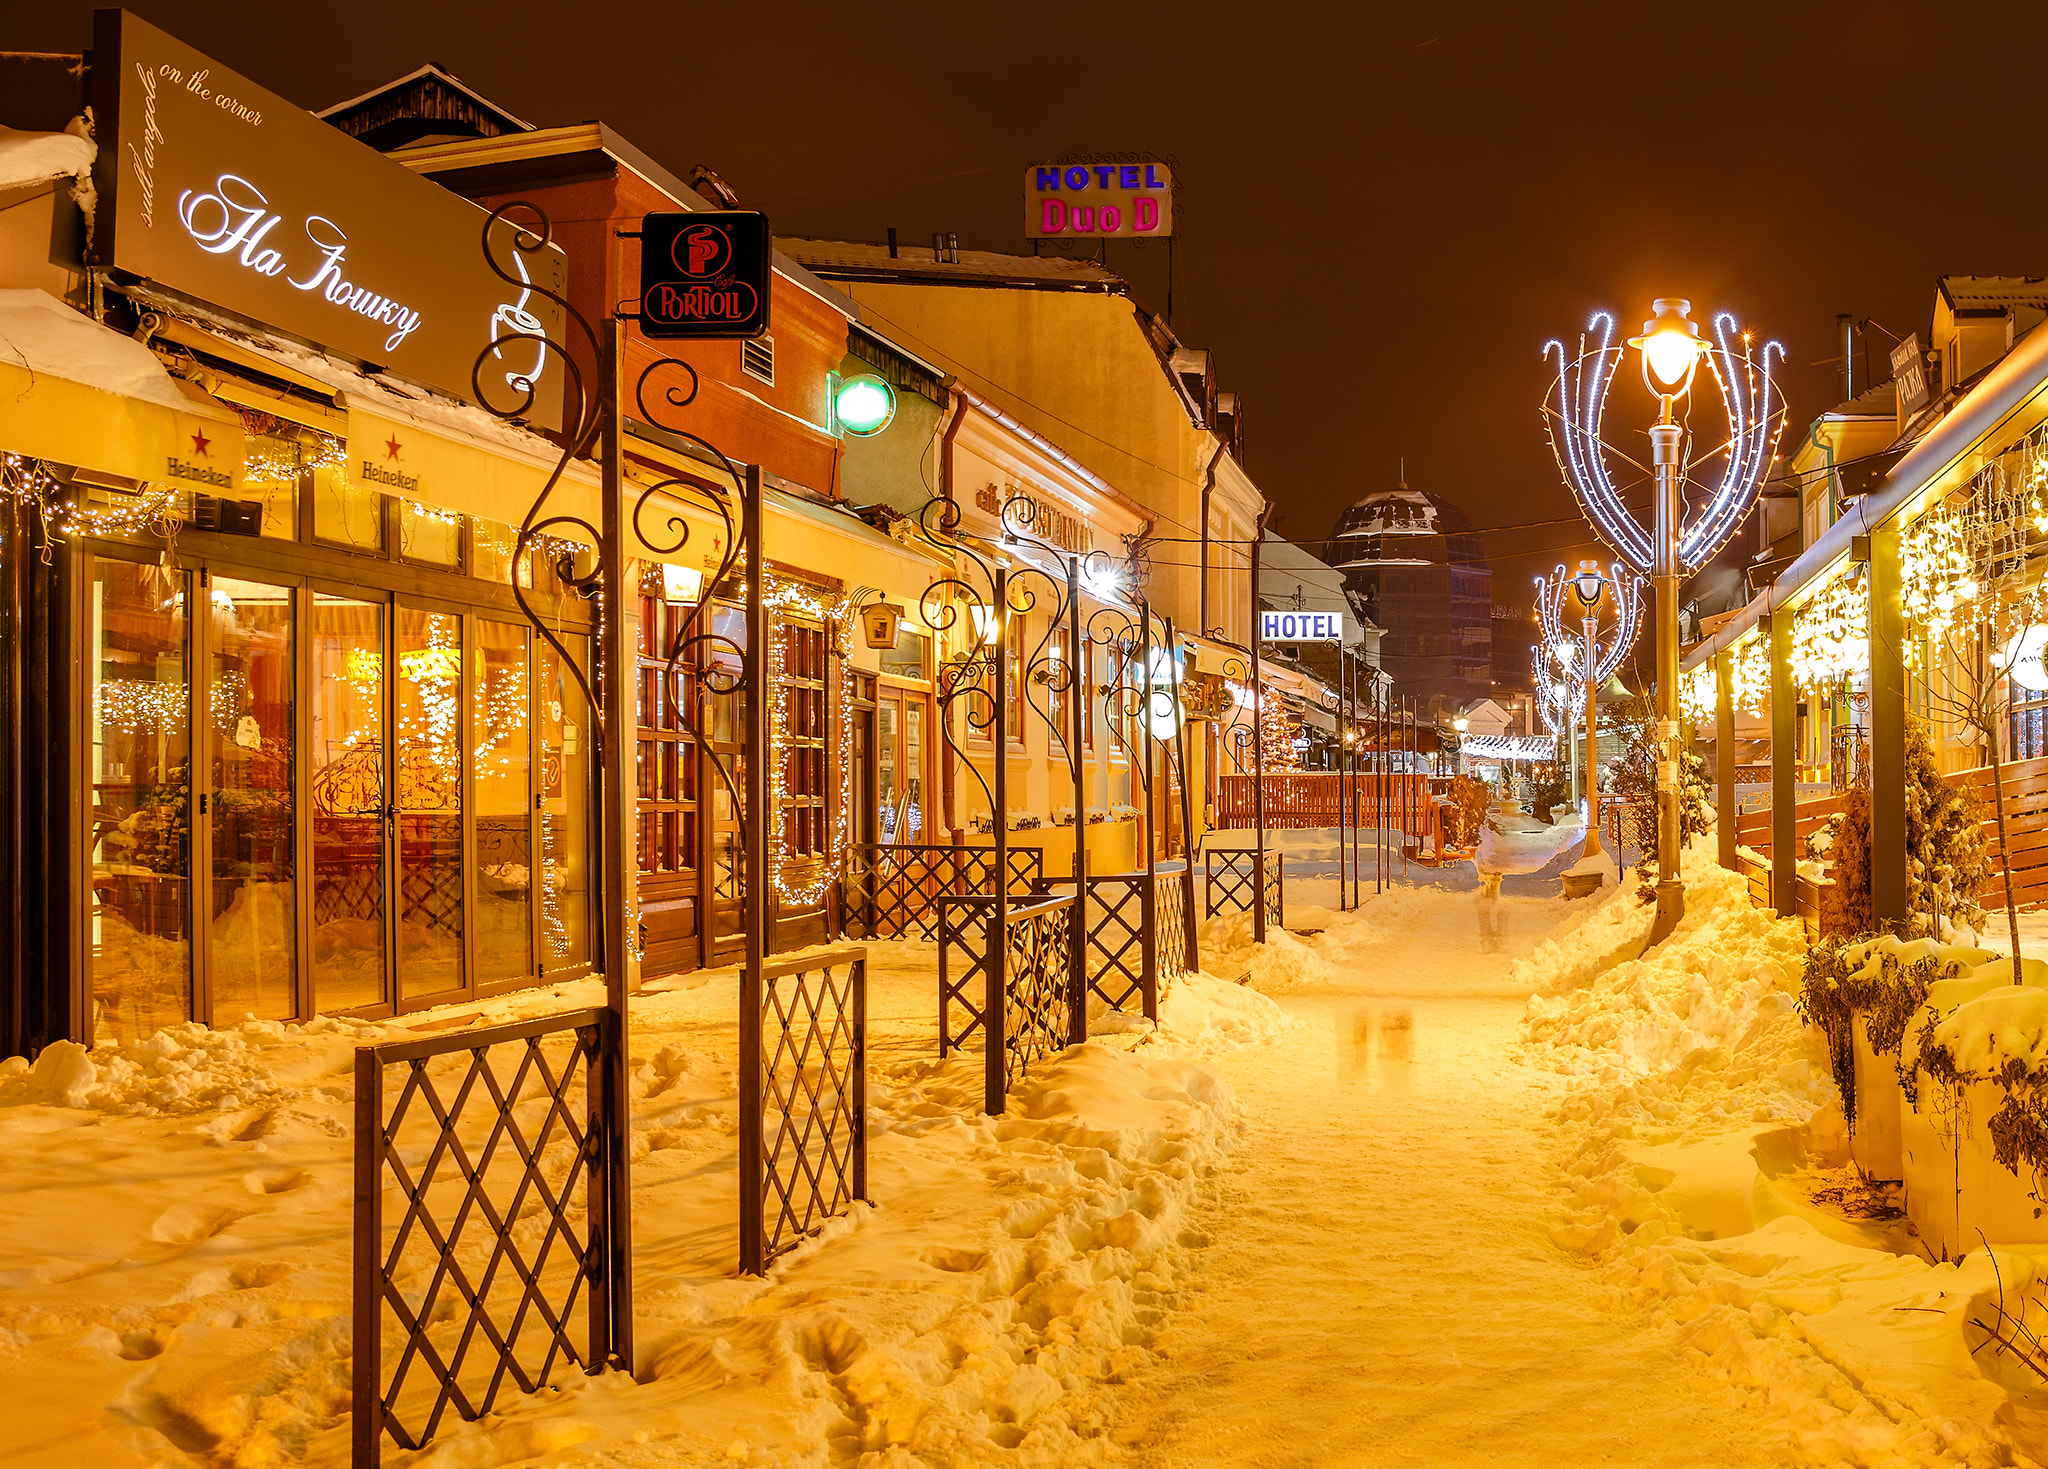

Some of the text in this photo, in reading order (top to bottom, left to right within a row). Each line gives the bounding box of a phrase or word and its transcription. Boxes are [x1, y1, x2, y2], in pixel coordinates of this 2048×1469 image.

[159, 62, 263, 127] on the corner
[1036, 165, 1165, 191] HOTEL
[177, 174, 287, 279] На
[1040, 197, 1160, 234] Duo D
[166, 456, 233, 489] Heineken
[361, 460, 420, 492] Heineken
[1264, 614, 1339, 638] HOTEL
